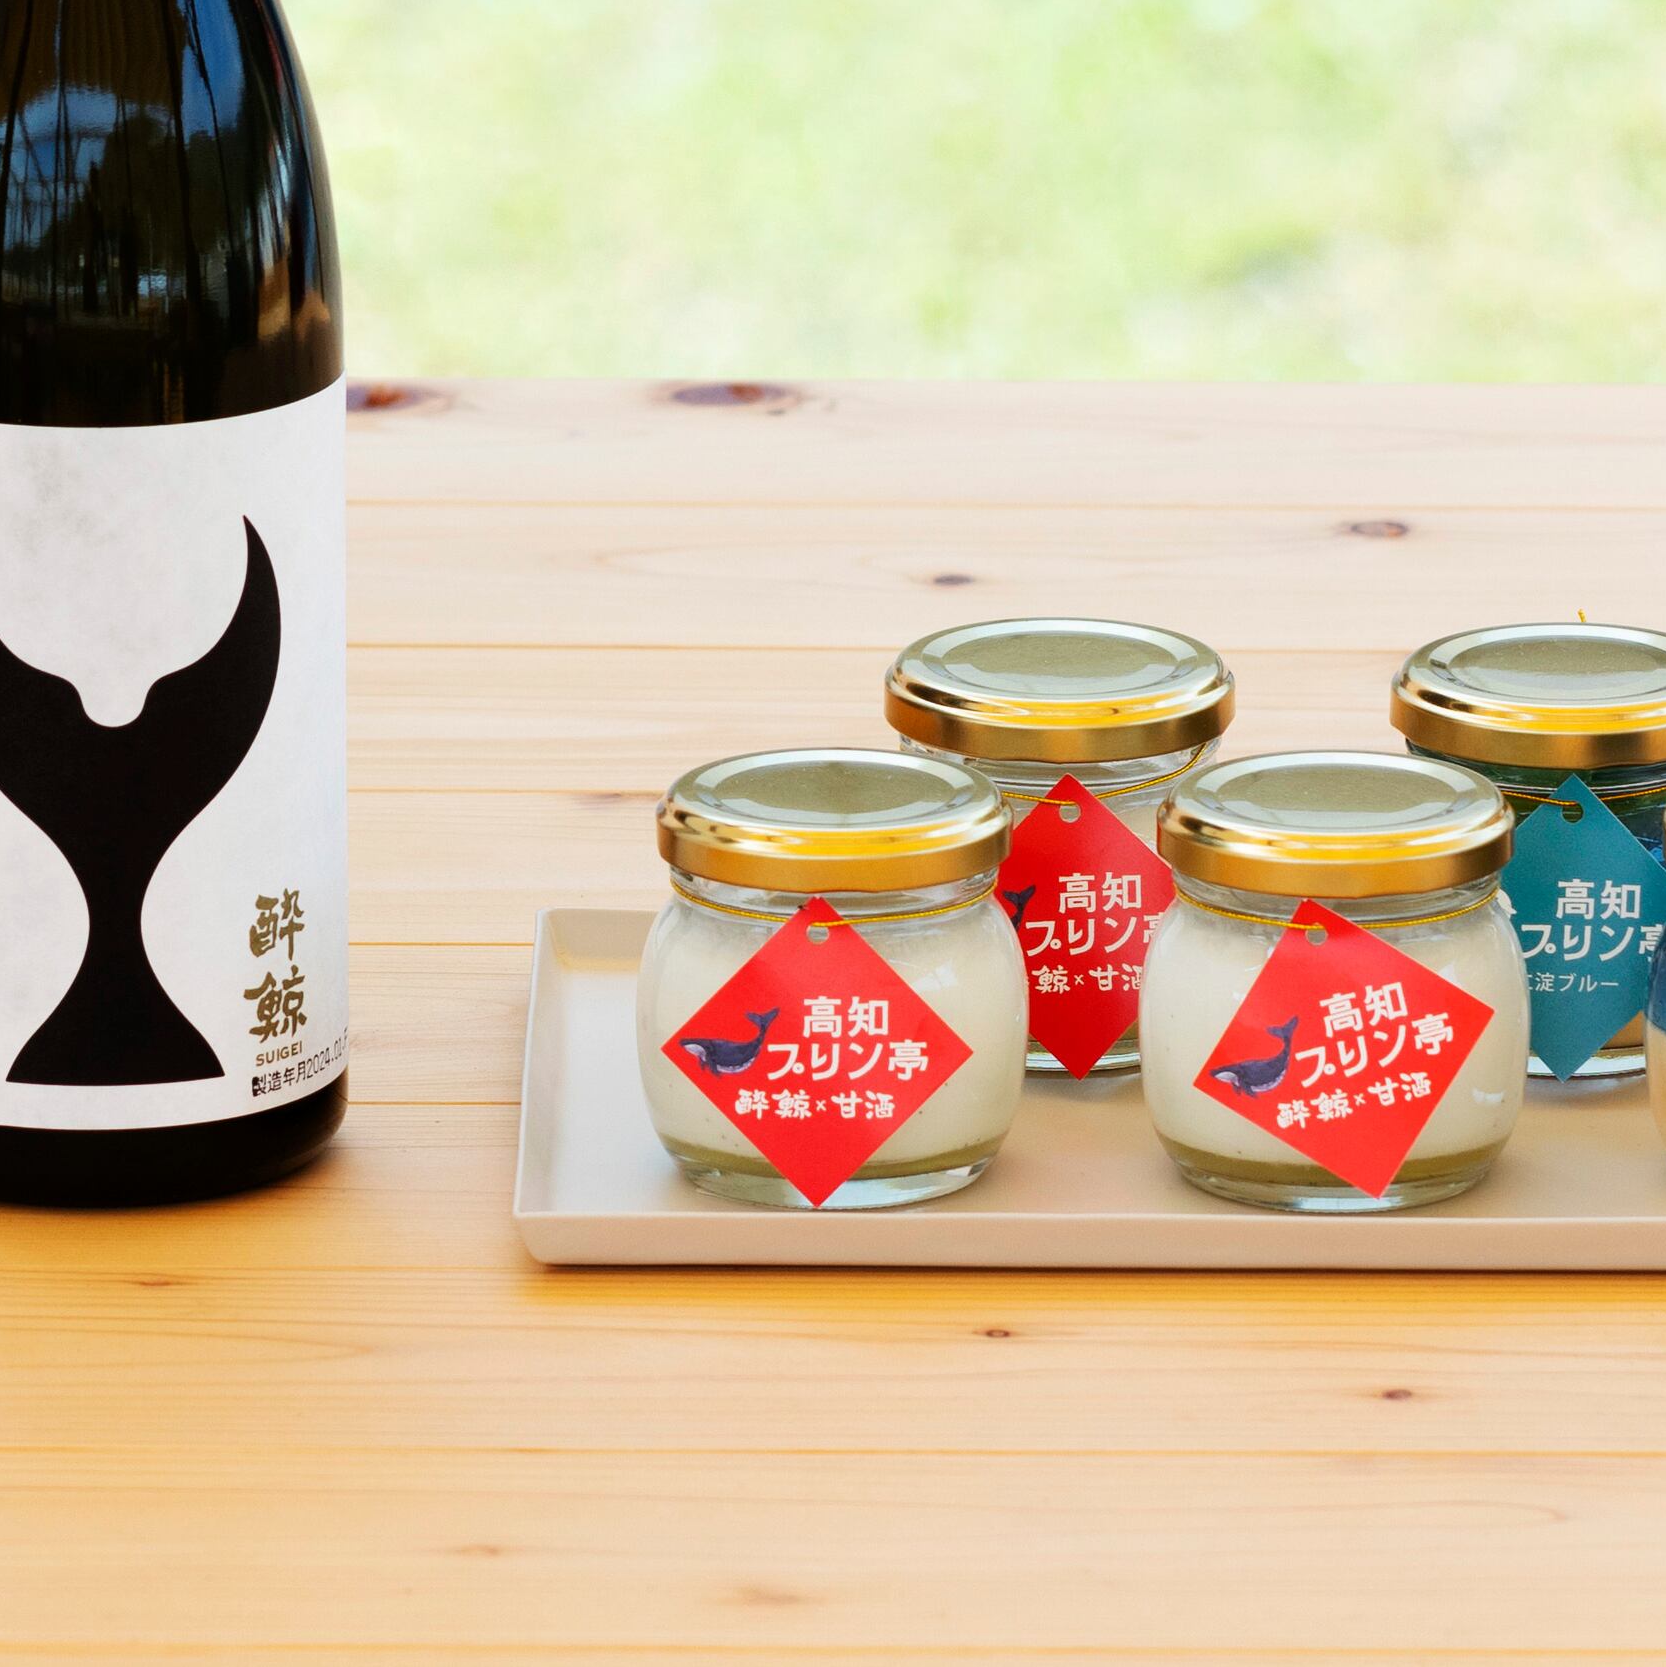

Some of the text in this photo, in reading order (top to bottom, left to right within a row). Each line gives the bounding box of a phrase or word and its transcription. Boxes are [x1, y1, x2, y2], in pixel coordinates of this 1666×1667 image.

[1057, 871, 1142, 914] 高知
[1555, 878, 1642, 920] 高知
[243, 887, 308, 1045] 酔鯨
[1026, 962, 1143, 995] 鯨×甘酒
[802, 995, 889, 1038] 高知
[1319, 981, 1409, 1038] 高知
[255, 1040, 303, 1068] SUIGEI
[766, 1038, 929, 1082] プリン亭
[1294, 1012, 1454, 1088] プリン亭
